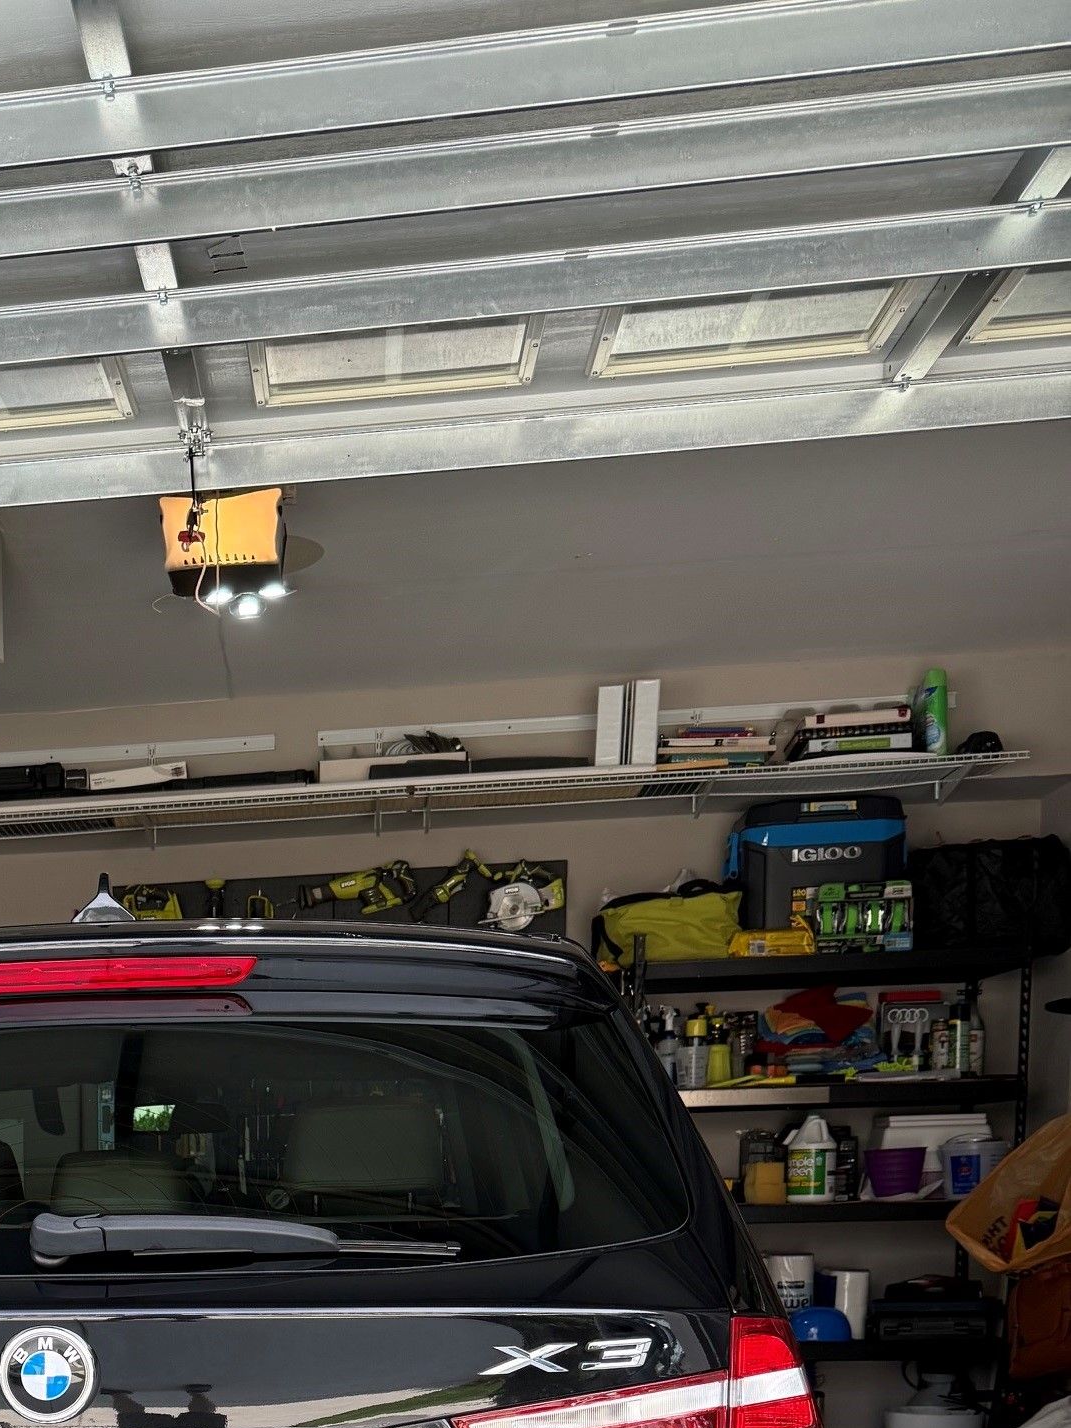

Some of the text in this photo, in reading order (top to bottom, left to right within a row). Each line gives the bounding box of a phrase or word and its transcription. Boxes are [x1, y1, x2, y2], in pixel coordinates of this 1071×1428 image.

[791, 847, 861, 863] IGLOO
[12, 1337, 80, 1364] BMW
[478, 1338, 652, 1375] X3
